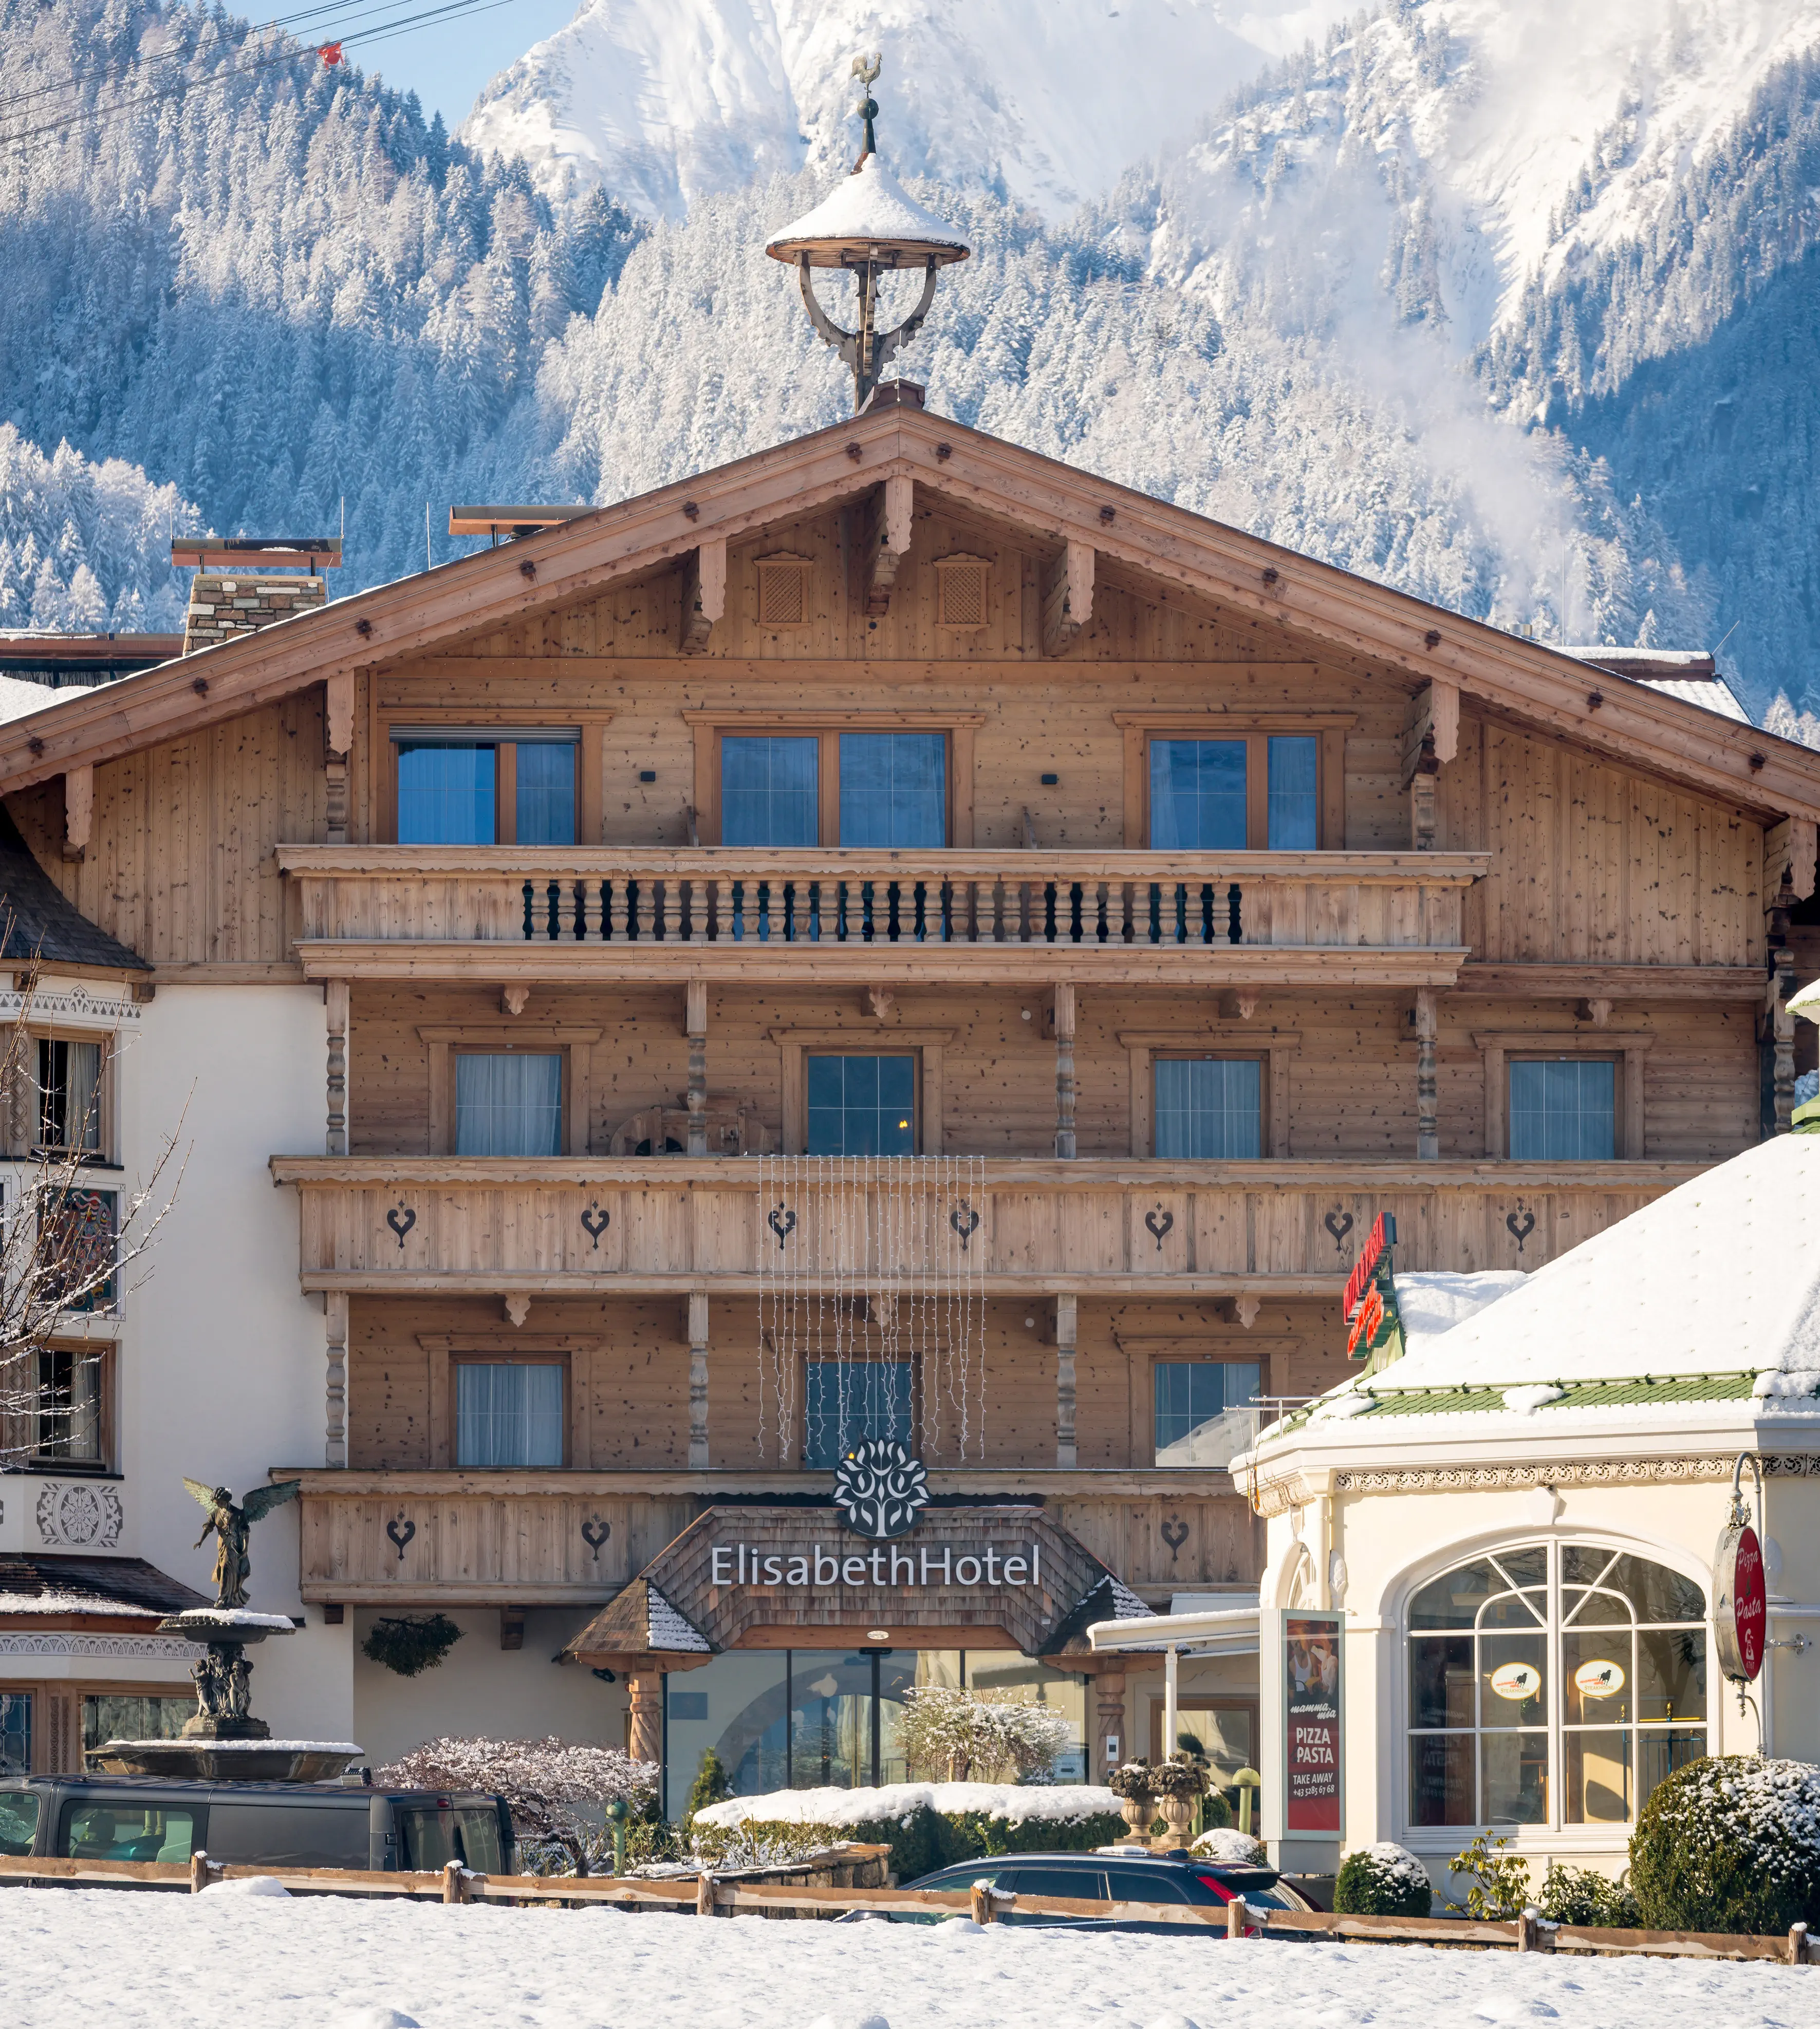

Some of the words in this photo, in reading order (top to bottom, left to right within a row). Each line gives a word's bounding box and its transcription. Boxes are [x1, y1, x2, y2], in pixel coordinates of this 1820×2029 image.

[711, 1544, 1039, 1586] ElisabethHotel
[1738, 1548, 1759, 1573] Pizza
[1736, 1597, 1762, 1625] Pasta
[1290, 1703, 1330, 1714] mamma
[1317, 1707, 1336, 1720] mia
[1296, 1727, 1331, 1744] PIZZA
[1297, 1746, 1334, 1763] PASTA
[1293, 1774, 1310, 1785] TAKE
[1311, 1772, 1333, 1784] AWAY
[1293, 1788, 1304, 1797] +43
[1305, 1785, 1318, 1796] 5285
[1318, 1785, 1326, 1795] 67
[1327, 1784, 1334, 1793] 68
